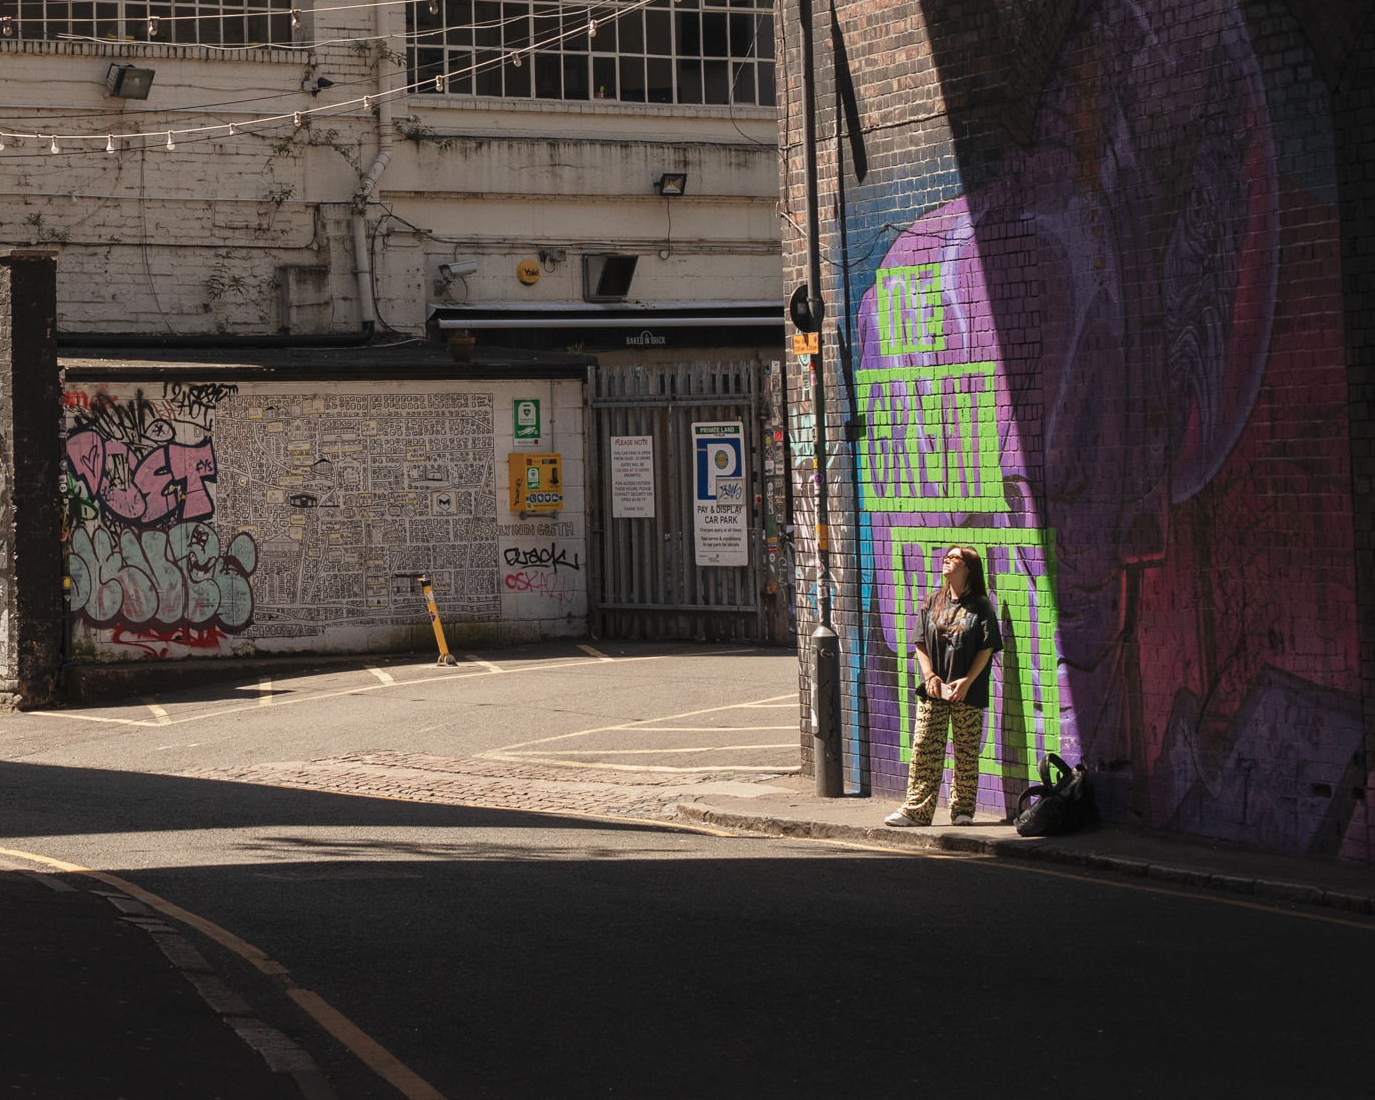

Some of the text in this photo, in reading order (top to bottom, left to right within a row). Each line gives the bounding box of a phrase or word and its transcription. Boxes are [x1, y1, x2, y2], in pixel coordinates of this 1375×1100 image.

[524, 268, 538, 276] Yale
[883, 270, 936, 349] THE
[698, 505, 743, 513] PAY & DISPLAY
